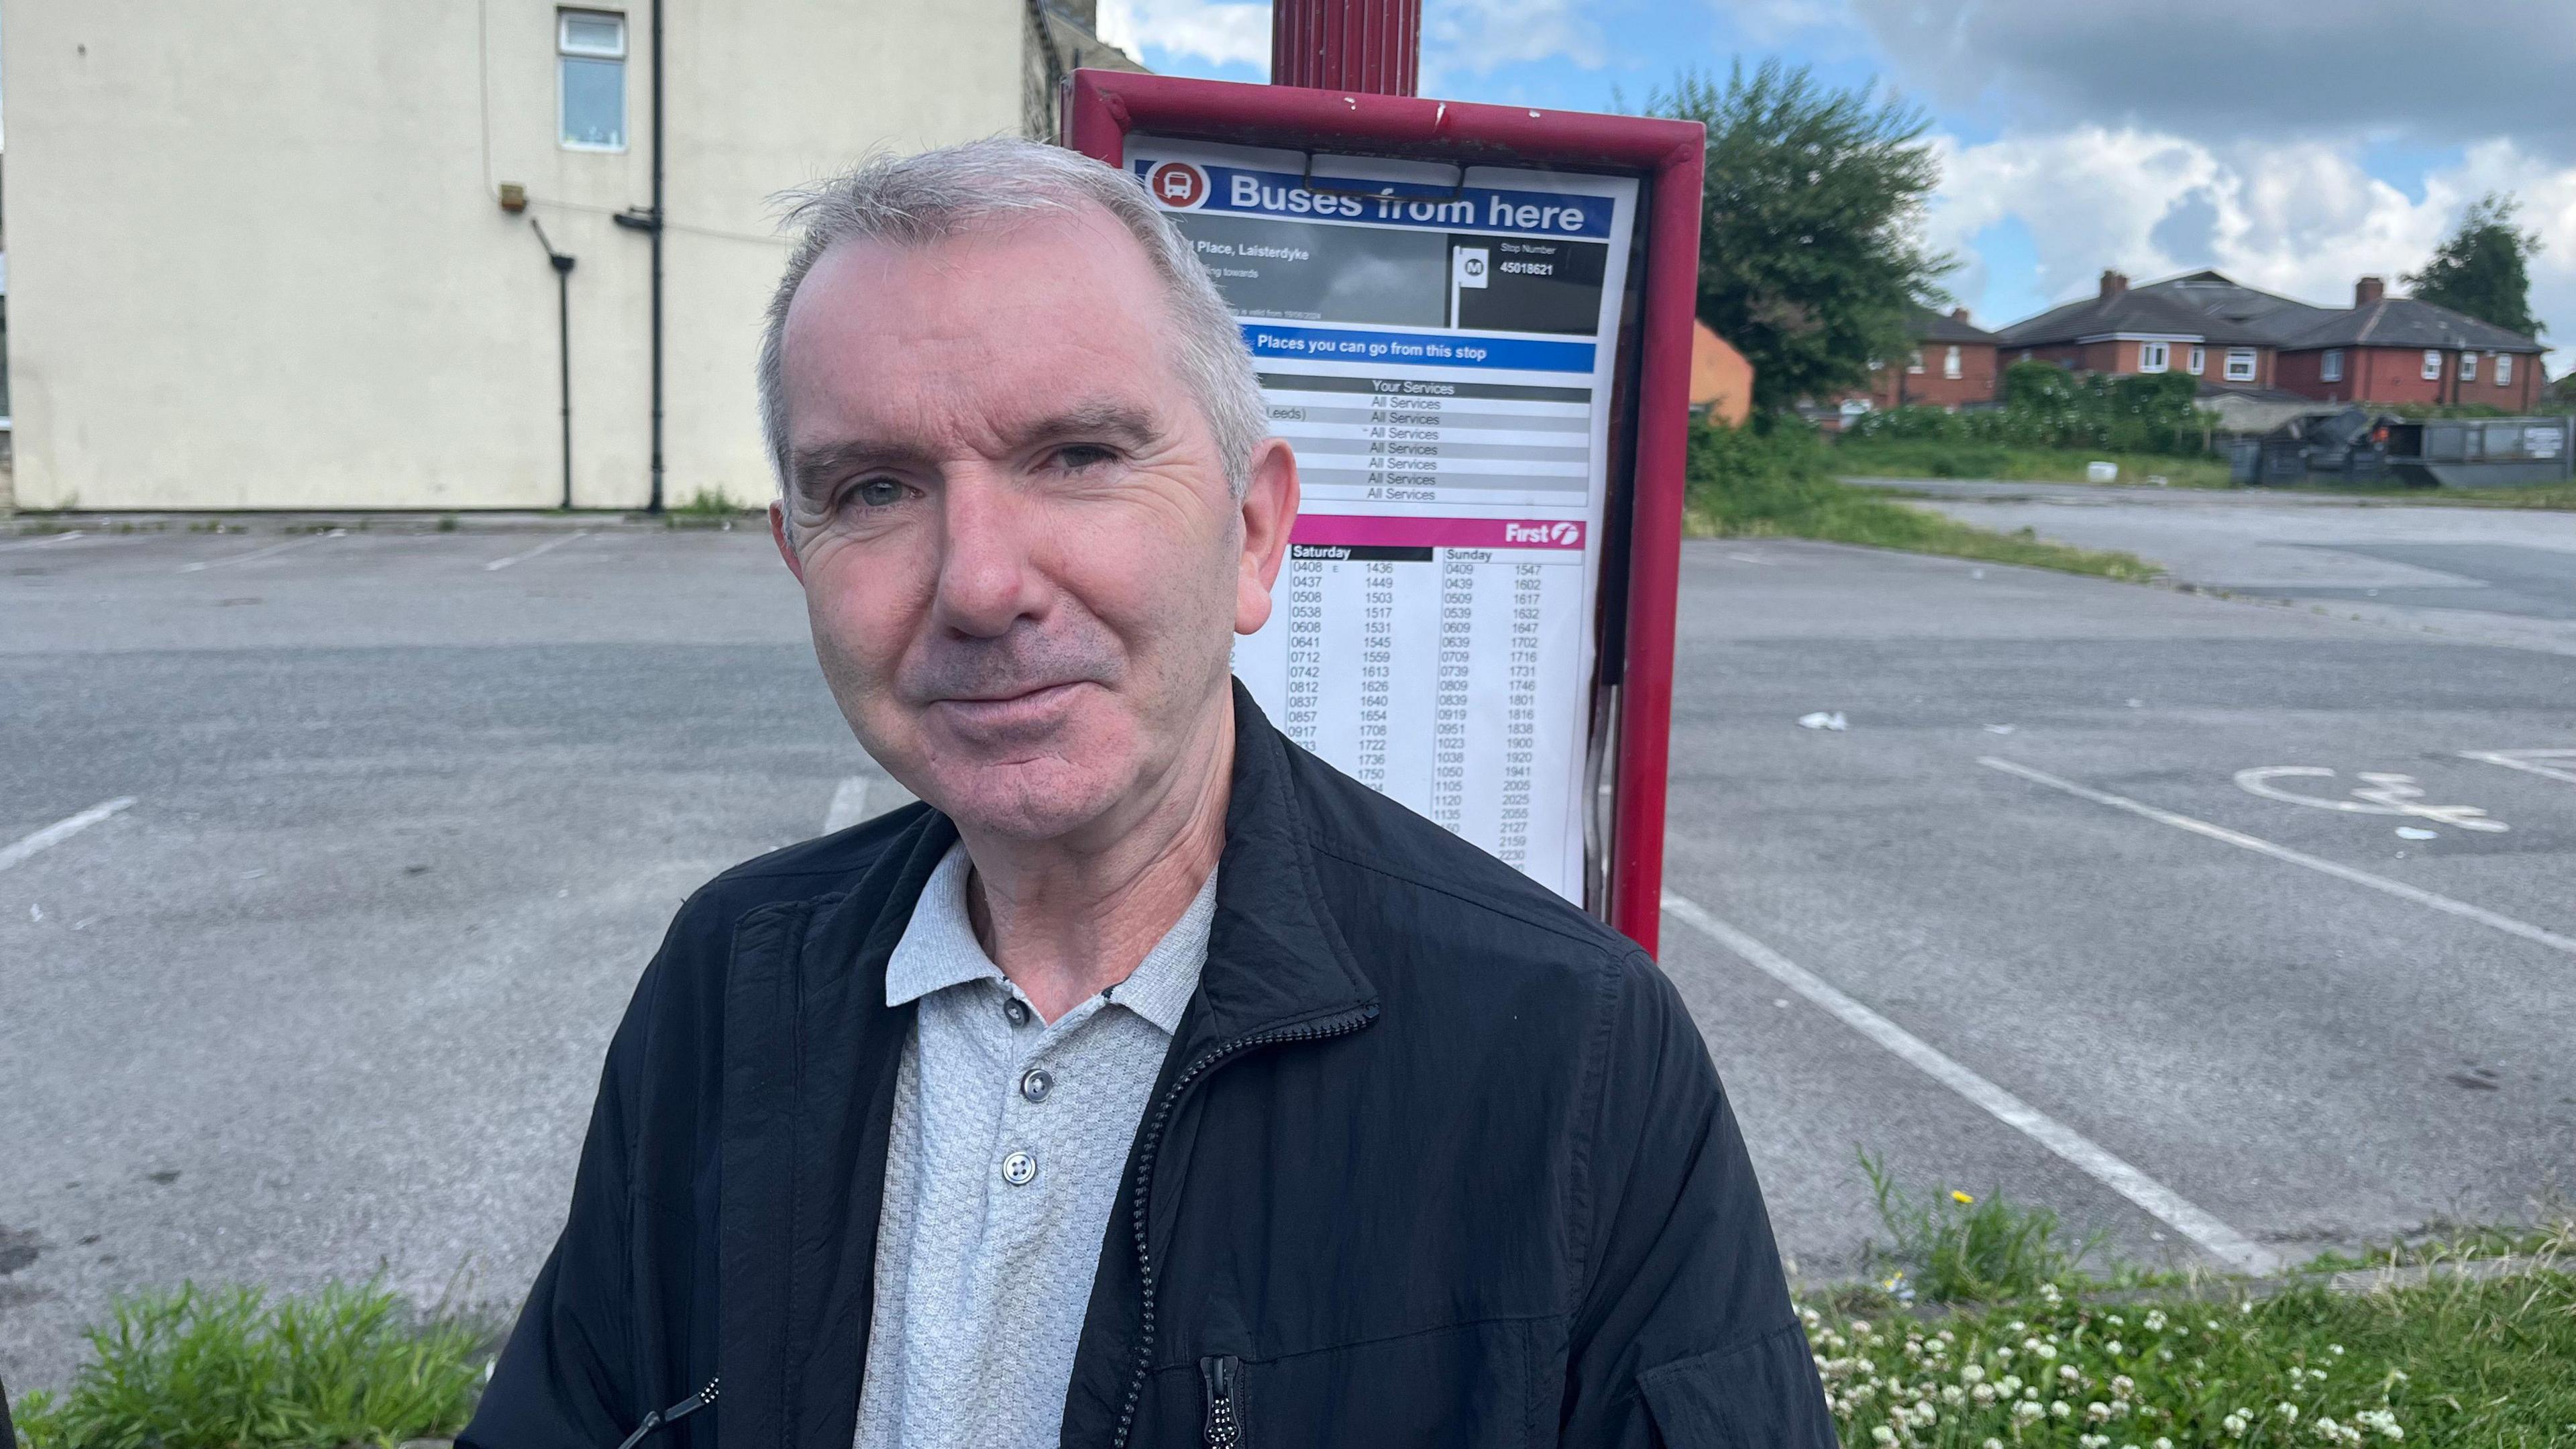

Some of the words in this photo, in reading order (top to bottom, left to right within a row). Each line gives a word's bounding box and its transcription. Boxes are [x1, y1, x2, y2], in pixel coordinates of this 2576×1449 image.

[1230, 175, 1363, 217] Buses
[1379, 187, 1474, 226] from
[1489, 195, 1585, 231] here
[1197, 241, 1235, 256] Place,
[1239, 244, 1309, 262] Laisterdyke
[1500, 243, 1520, 254] Stop
[1521, 244, 1556, 254] Number
[1223, 267, 1259, 278] towards
[1500, 261, 1554, 276] 45018621
[1257, 334, 1305, 350] Places
[1308, 339, 1336, 354] you
[1340, 341, 1365, 354] can
[1369, 344, 1388, 358] go
[1391, 342, 1422, 356] from
[1426, 343, 1452, 358] this
[1455, 347, 1487, 362] stop
[1372, 380, 1401, 393] Your
[1403, 381, 1455, 395] Services
[1372, 396, 1387, 407] All
[1390, 397, 1441, 410] Services
[1266, 406, 1306, 421] Leeds)
[1371, 411, 1385, 423] All
[1389, 413, 1440, 425] Services
[1371, 427, 1385, 437] All
[1389, 427, 1439, 440] Services
[1370, 442, 1384, 453] All
[1388, 443, 1438, 455] Services
[1369, 458, 1383, 468] All
[1387, 458, 1437, 470] Services
[1368, 472, 1383, 483] All
[1387, 473, 1436, 485] Services
[1367, 488, 1382, 498] All
[1386, 488, 1435, 500] Services
[1505, 523, 1548, 543] First
[1293, 546, 1351, 561] Saturday
[1446, 550, 1491, 563] Sunday
[1294, 561, 1322, 572] 0408
[1366, 564, 1393, 573] 1436
[1446, 565, 1473, 574] 0409
[1515, 566, 1541, 575] 1547
[1293, 577, 1322, 587] 0437
[1366, 578, 1393, 588] 1449
[1446, 580, 1472, 589] 0439
[1515, 580, 1541, 590] 1602
[1293, 592, 1322, 602] 0508
[1366, 593, 1392, 603] 1503
[1445, 594, 1472, 604] 0509
[1514, 595, 1540, 604] 1617
[1292, 607, 1321, 618] 0538
[1365, 608, 1392, 618] 1517
[1444, 609, 1470, 619] 0539
[1513, 610, 1539, 619] 1632
[1291, 623, 1320, 633] 0608
[1365, 624, 1390, 633] 1531
[1444, 623, 1470, 633] 0609
[1513, 623, 1538, 633] 1647
[1291, 637, 1319, 647] 0641
[1364, 637, 1391, 647] 1545
[1443, 638, 1469, 647] 0639
[1512, 638, 1538, 648] 1702
[1291, 652, 1320, 663] 0712
[1363, 652, 1390, 662] 1559
[1442, 652, 1468, 662] 0709
[1511, 653, 1536, 662] 1716
[1290, 667, 1319, 678] 0742
[1362, 667, 1389, 677] 1613
[1441, 667, 1468, 676] 0739
[1510, 667, 1535, 676] 1731
[1290, 682, 1318, 692] 0812
[1362, 682, 1389, 692] 1626
[1440, 681, 1467, 691] 0809
[1509, 682, 1534, 691] 1746
[1289, 697, 1318, 707] 0837
[1360, 696, 1387, 706] 1640
[1440, 696, 1467, 705] 0839
[1509, 696, 1534, 705] 1801
[1289, 712, 1316, 722] 0857
[1360, 711, 1387, 721] 1654
[1438, 710, 1466, 720] 0919
[1508, 710, 1534, 719] 1816
[1288, 727, 1316, 737] 0917
[1508, 724, 1533, 734] 1838
[1359, 741, 1385, 750] 1722
[1438, 739, 1464, 749] 1023
[1507, 739, 1532, 748] 1900
[1507, 753, 1532, 763] 1920
[1358, 770, 1384, 780] 1750
[1437, 767, 1462, 777] 1050
[1506, 767, 1530, 776] 1941
[1435, 796, 1461, 806] 1120
[1503, 794, 1529, 805] 2025
[1435, 810, 1460, 820] 1135
[1500, 823, 1527, 833] 2127
